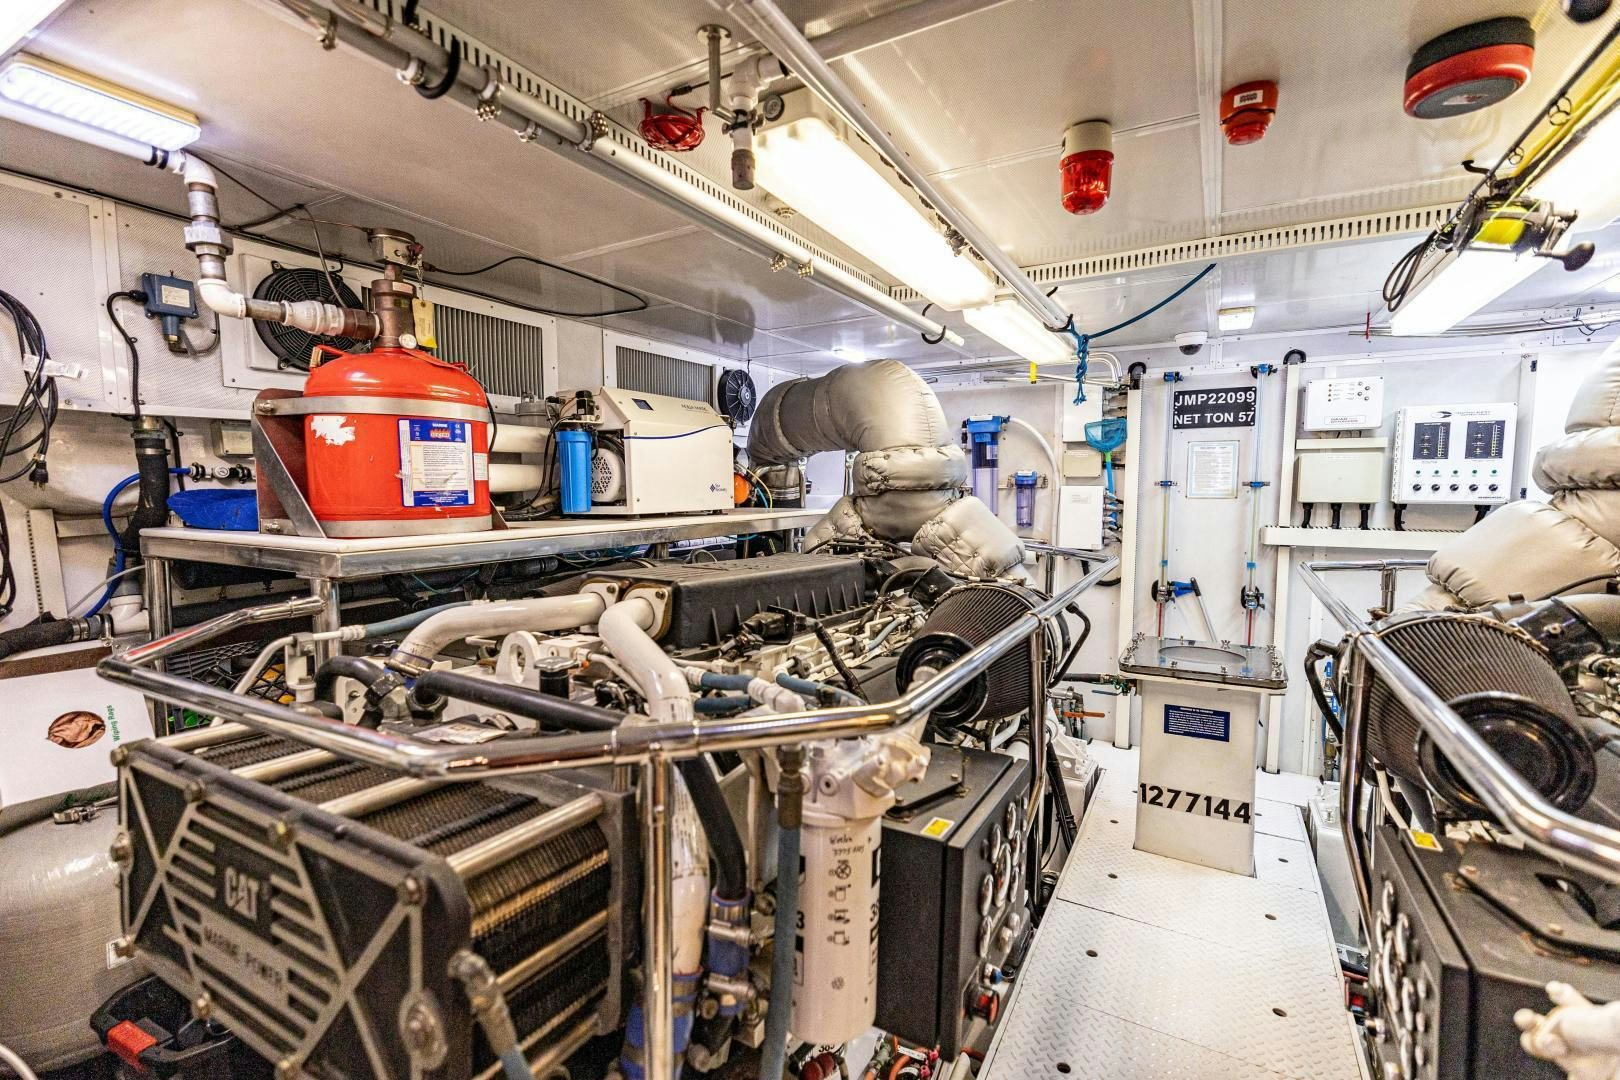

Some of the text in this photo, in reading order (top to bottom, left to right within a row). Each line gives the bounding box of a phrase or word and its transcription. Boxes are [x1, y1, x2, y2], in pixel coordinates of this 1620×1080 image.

[1175, 391, 1255, 406] JMP22099
[1173, 411, 1255, 425] NET TON 57
[1140, 783, 1251, 824] 1277144
[225, 867, 259, 920] CAT
